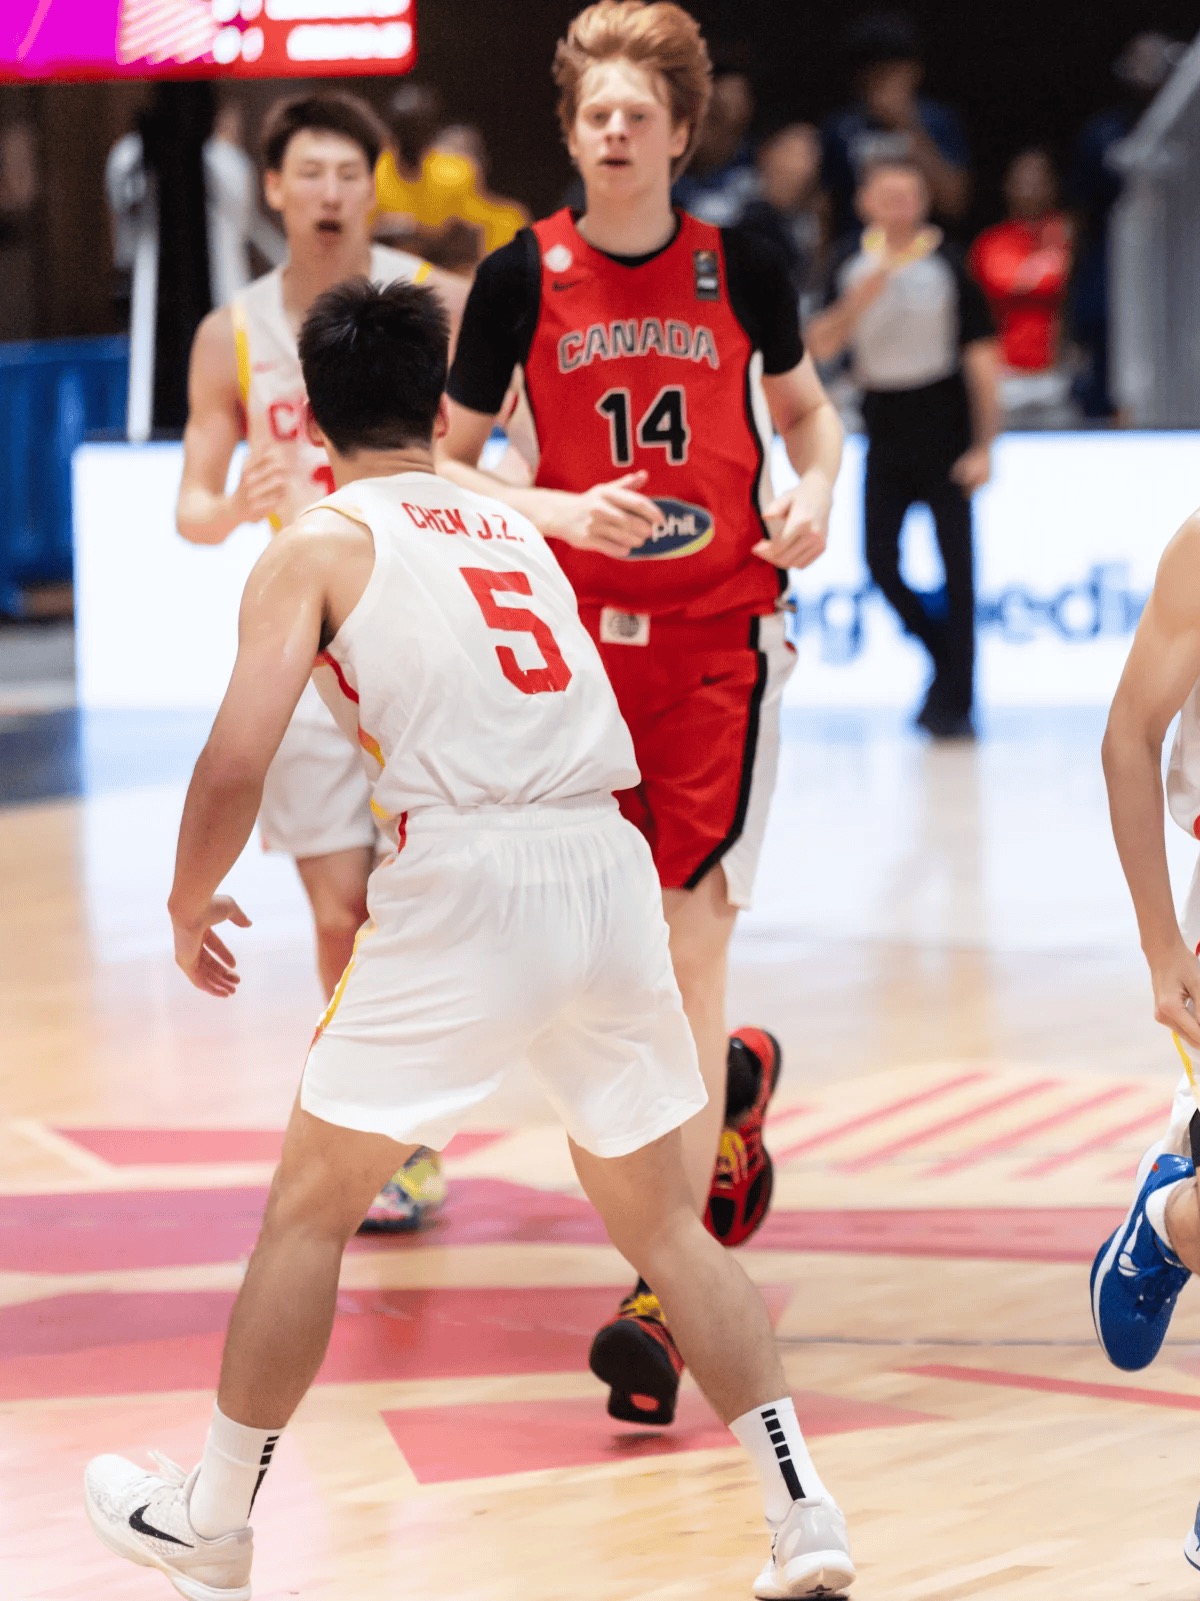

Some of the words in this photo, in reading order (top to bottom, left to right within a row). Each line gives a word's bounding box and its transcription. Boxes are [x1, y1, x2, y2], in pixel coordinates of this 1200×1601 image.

[557, 317, 720, 374] CANADA
[595, 384, 692, 468] 14
[402, 501, 470, 537] CHEN
[652, 513, 698, 543] phil
[458, 566, 573, 695] 5
